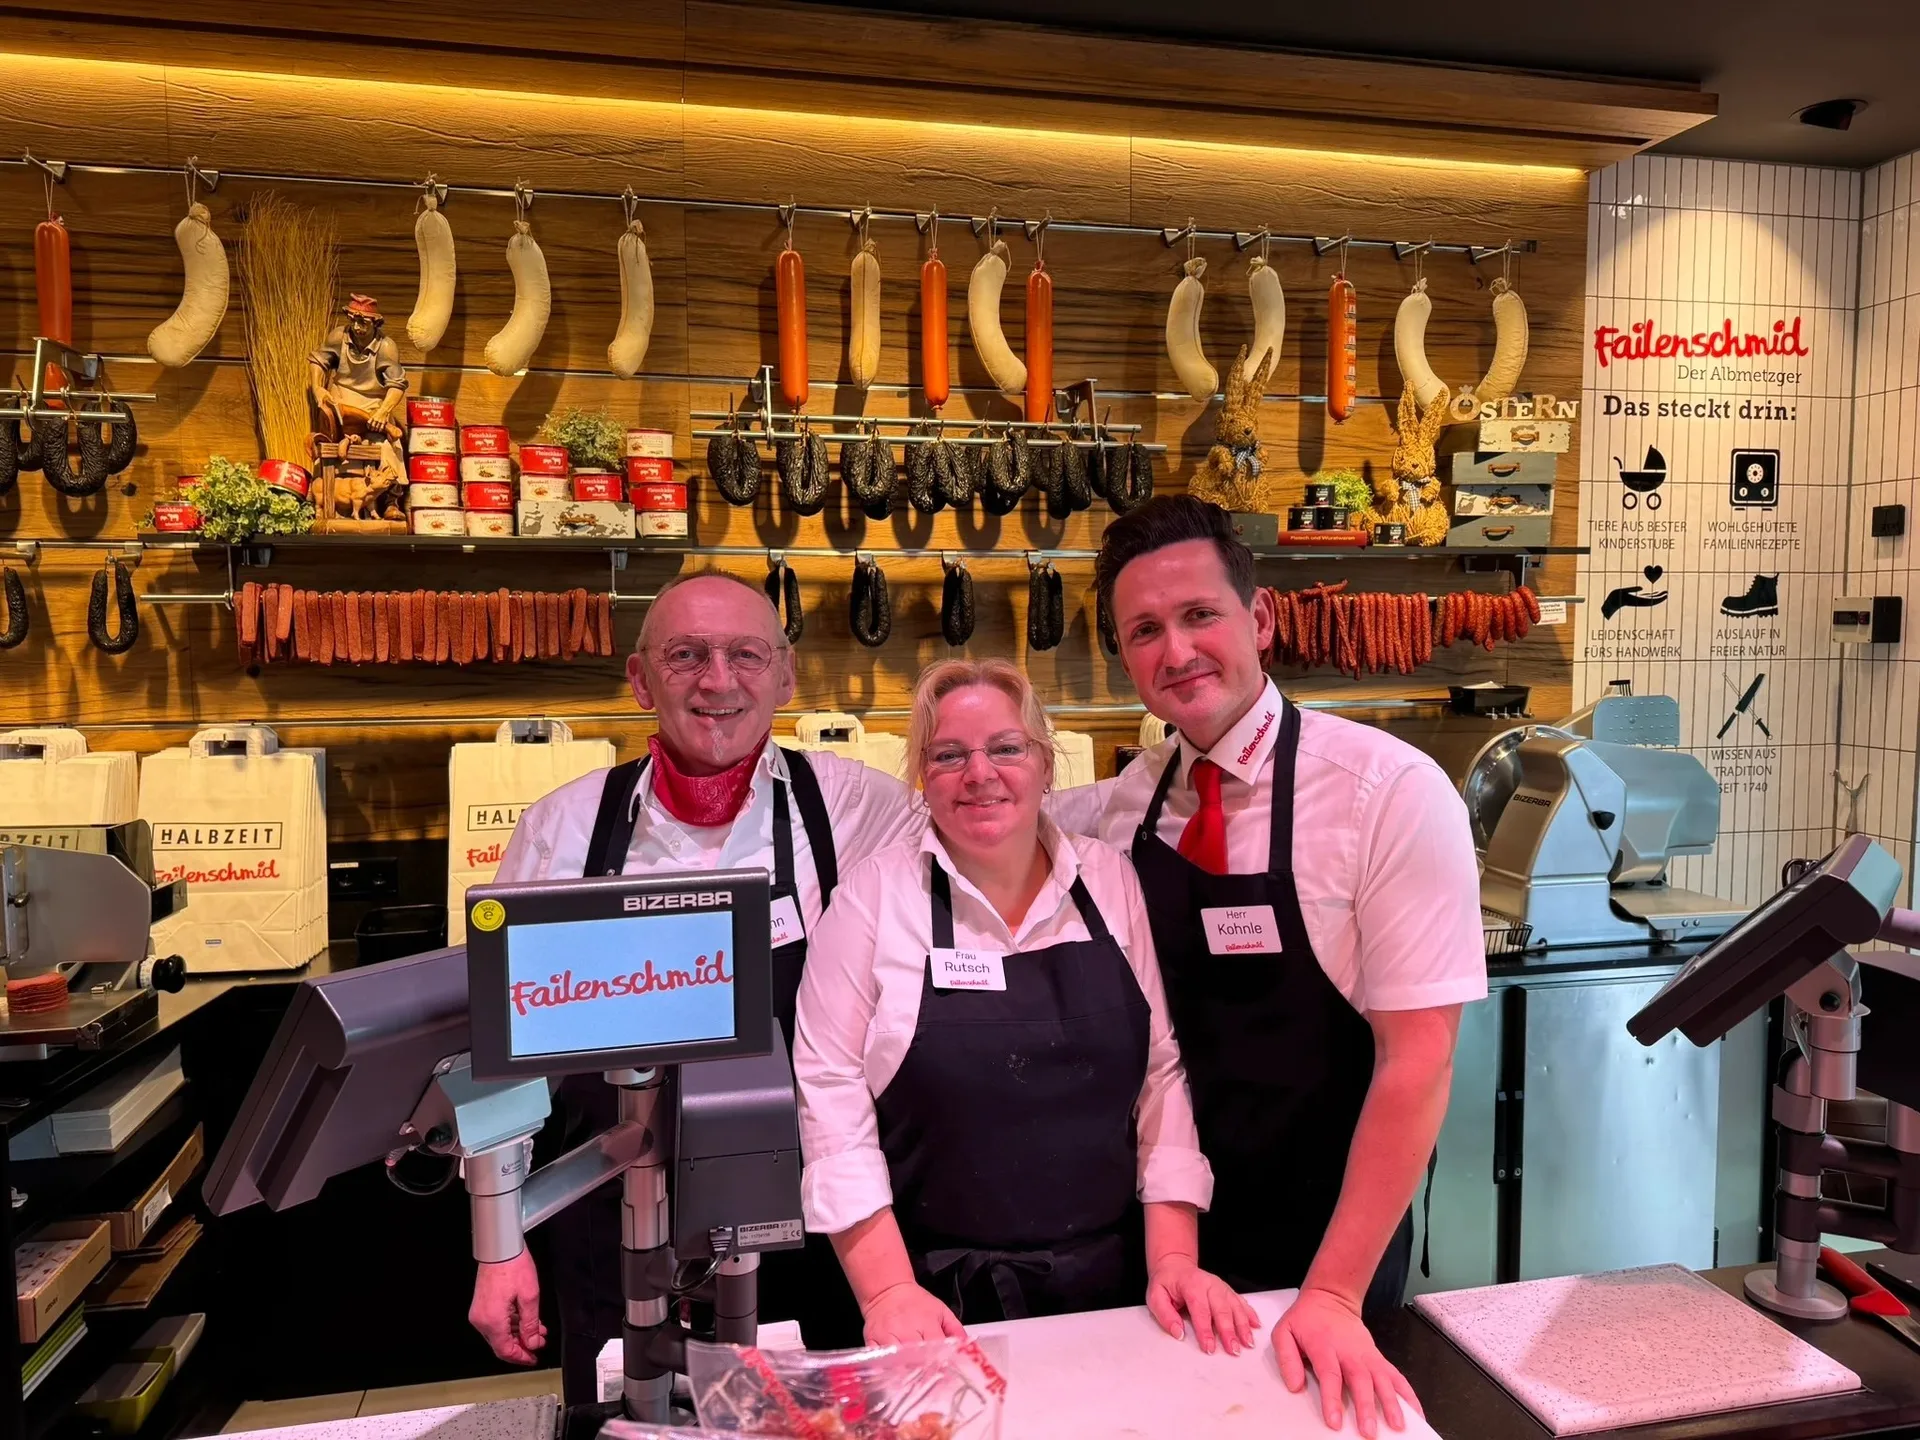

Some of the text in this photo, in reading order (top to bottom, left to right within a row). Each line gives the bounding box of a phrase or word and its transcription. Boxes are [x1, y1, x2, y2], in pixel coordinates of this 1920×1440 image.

[1594, 316, 1808, 367] Failenschmid
[1677, 365, 1802, 386] Der Albmetzger
[1603, 395, 1796, 421] Das steckt drin:
[1587, 520, 1687, 533] TIERE AUS BESTER
[1708, 520, 1798, 533] WOHLGEHÜTETE
[1599, 538, 1675, 550] KINDERSTUBE
[1703, 538, 1800, 550] FAMILIENREZEPTE
[1591, 629, 1675, 641] LEIDENSCHAFT
[1716, 628, 1780, 640] AUSLAUF IN
[1584, 645, 1681, 658] FÜRS HANDWERK
[1710, 645, 1786, 657] FREIER NATUR
[1237, 711, 1275, 766] Failenschmid
[1711, 748, 1776, 760] WISSEN AUS
[1714, 765, 1772, 776] TRADITION
[1743, 782, 1768, 792] 1740
[1513, 794, 1551, 807] BIZERBA
[477, 809, 526, 824] HAL
[161, 828, 273, 844] HALBZEIT
[623, 891, 733, 912] BIZERBA
[1226, 910, 1247, 919] Herr
[1217, 922, 1263, 936] Kohnle
[955, 951, 976, 960] Frau
[944, 961, 990, 973] Rutsch
[509, 949, 734, 1017] Failenschmid
[740, 1223, 779, 1232] BIZERBA
